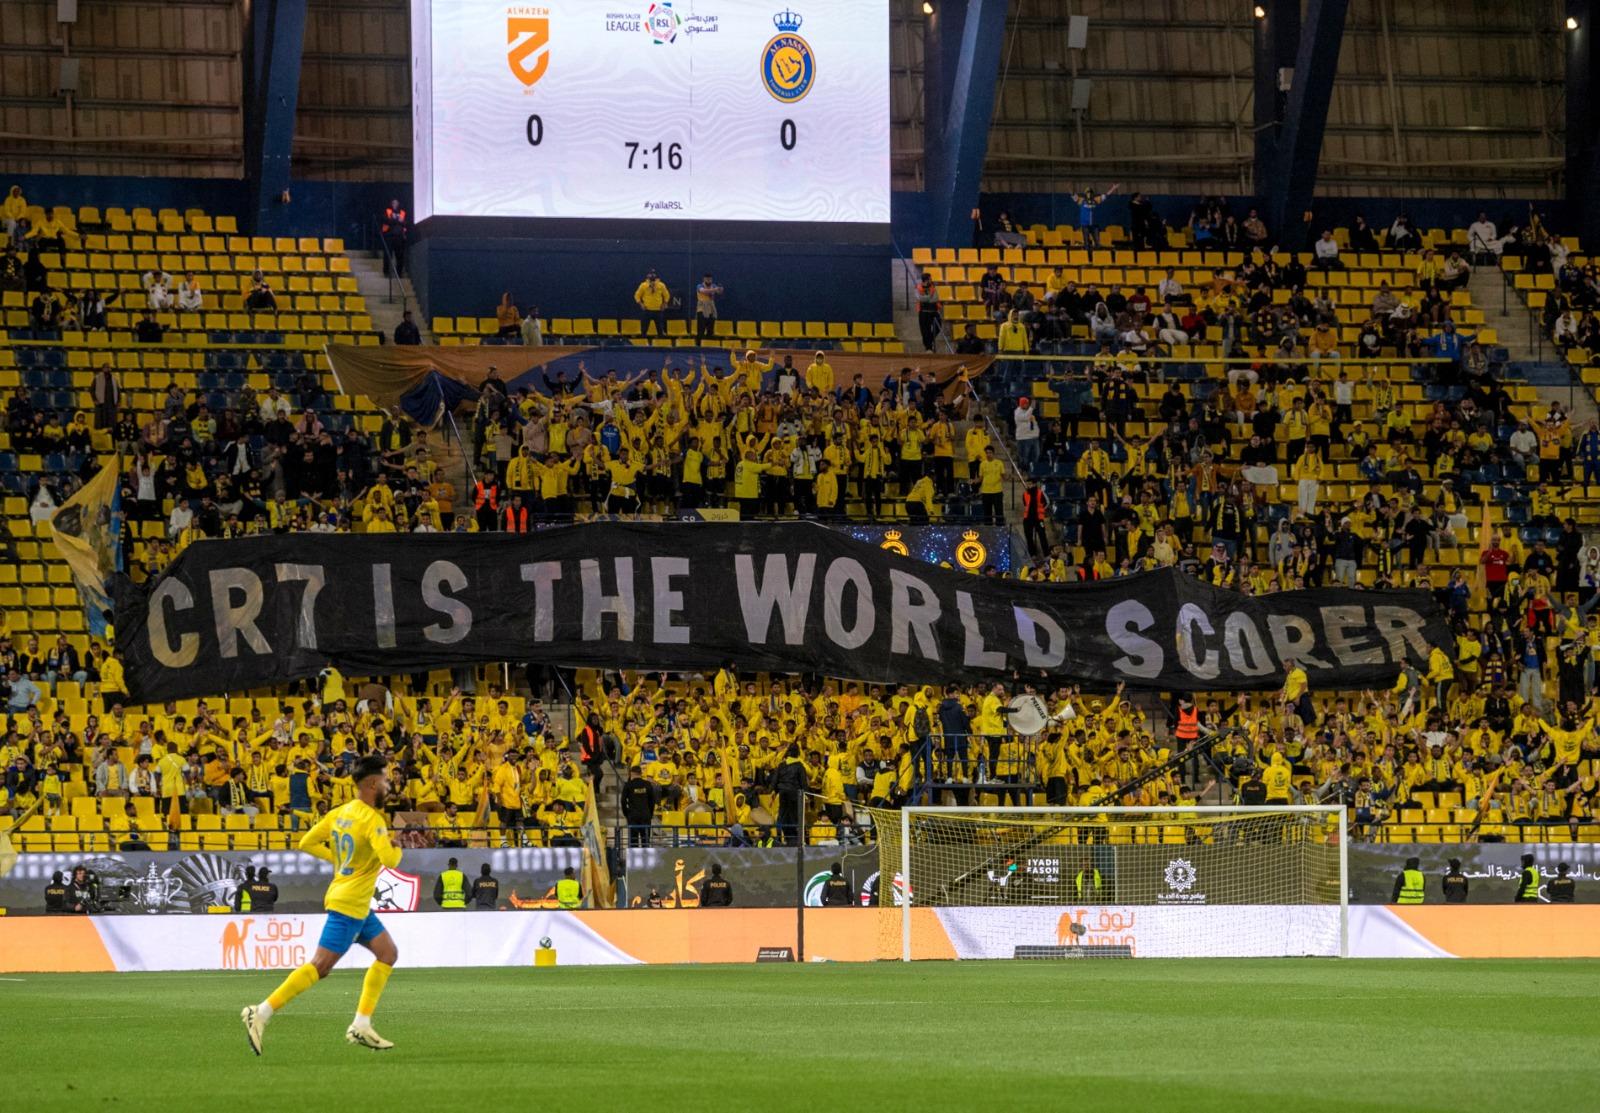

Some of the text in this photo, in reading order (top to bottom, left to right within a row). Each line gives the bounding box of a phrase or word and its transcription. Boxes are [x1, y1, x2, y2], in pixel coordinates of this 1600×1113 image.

[507, 7, 549, 15] ALHAZEM
[606, 21, 640, 32] LEAGUE
[656, 18, 669, 28] RSL
[684, 24, 718, 35] السعودي
[526, 114, 543, 146] 0
[780, 119, 796, 151] 0
[624, 141, 683, 170] 7:16
[644, 200, 683, 211] #yallaRSL
[147, 553, 1430, 680] CR7 IS THE WORLD SCORER
[710, 881, 727, 889] POLICE
[255, 917, 304, 941] نوق
[255, 945, 305, 968] NOUG
